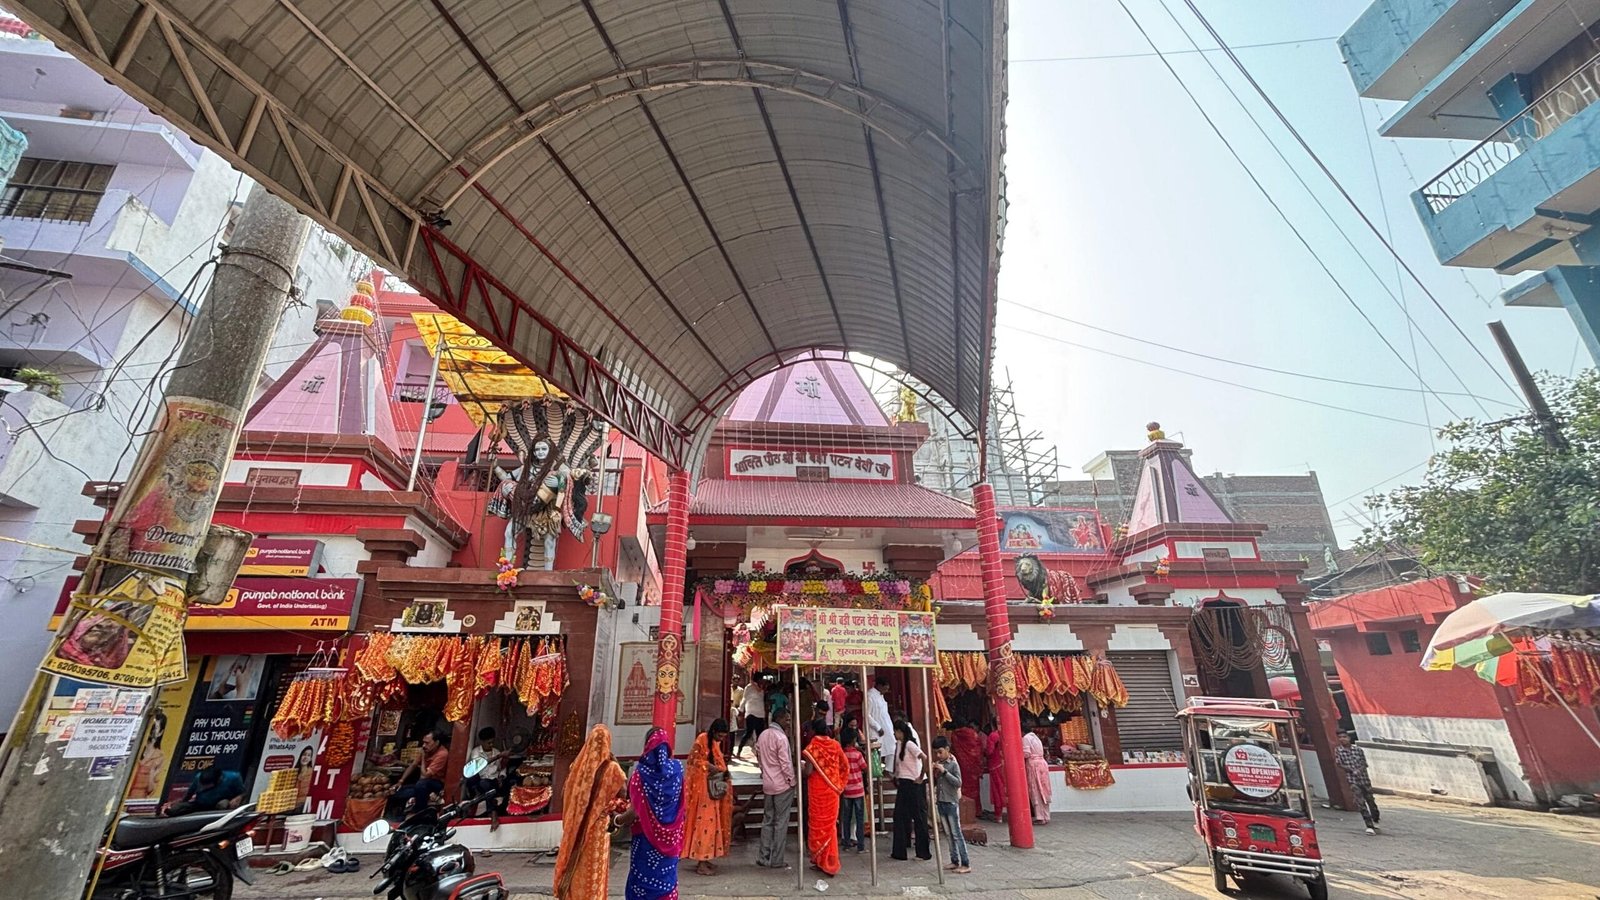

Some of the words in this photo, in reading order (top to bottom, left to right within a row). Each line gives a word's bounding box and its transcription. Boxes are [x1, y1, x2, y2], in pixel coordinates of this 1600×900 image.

[875, 462, 890, 478] जी
[240, 589, 277, 603] punjab
[279, 589, 319, 600] national
[320, 589, 346, 600] bank
[310, 618, 338, 627] ATM
[82, 717, 109, 725] HOME
[193, 718, 207, 728] PAY
[210, 717, 231, 727] YOUR
[189, 731, 208, 742] BILLS
[211, 730, 247, 741] THROUGH
[185, 745, 203, 756] JUST
[205, 744, 222, 754] ONE
[222, 744, 238, 754] APP
